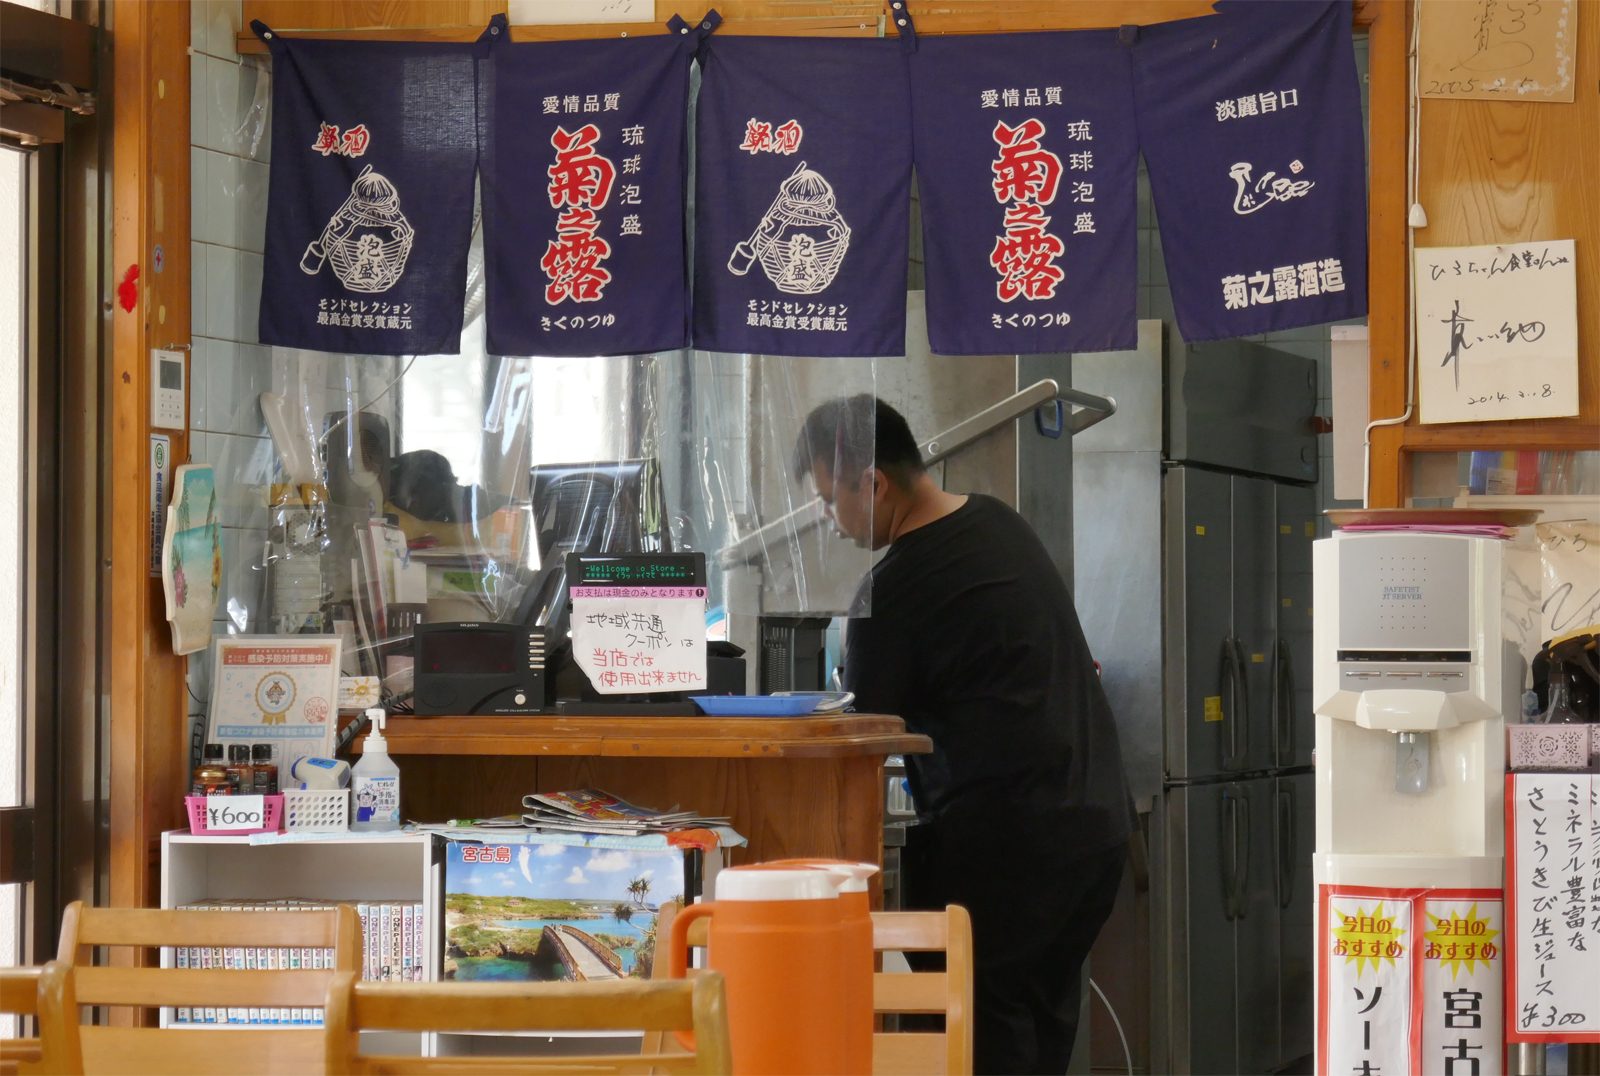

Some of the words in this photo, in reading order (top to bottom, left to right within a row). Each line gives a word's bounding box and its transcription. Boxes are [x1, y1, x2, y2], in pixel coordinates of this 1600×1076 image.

[542, 92, 620, 114] 愛情品質
[981, 86, 1063, 109] 愛情品質
[1215, 88, 1299, 122] 淡麗旨口
[620, 124, 645, 237] 琉球泡盛
[1067, 119, 1096, 235] 琉球泡盛
[540, 123, 616, 306] 菊之露
[990, 118, 1065, 303] 菊之露
[358, 234, 384, 282] 泡盛
[790, 234, 814, 282] 泡盛
[1221, 258, 1345, 311] 菊之露酒造
[317, 298, 413, 315] モンドセレクション
[747, 300, 849, 316] モンドセレクション
[317, 311, 413, 330] 最高金賞受賞蔵元
[541, 313, 616, 332] きくのつゆ
[746, 312, 848, 332] 最高金賞受賞蔵元
[991, 312, 1071, 330] きくのつゆ
[586, 612, 666, 634] 地域共通
[592, 647, 654, 668] 当店では
[599, 669, 702, 688] 使用出来ません
[209, 806, 260, 827] ¥600
[461, 845, 512, 864] 宮古島
[1561, 783, 1587, 952] ミネラル豊富な
[1527, 786, 1558, 997] さとうきび生ジュース
[1343, 915, 1393, 934] 今日の
[1436, 918, 1486, 936] 今日の
[1333, 939, 1403, 958] おすすめ
[1425, 942, 1498, 960] おすすめ
[1521, 1002, 1587, 1028] ¥300
